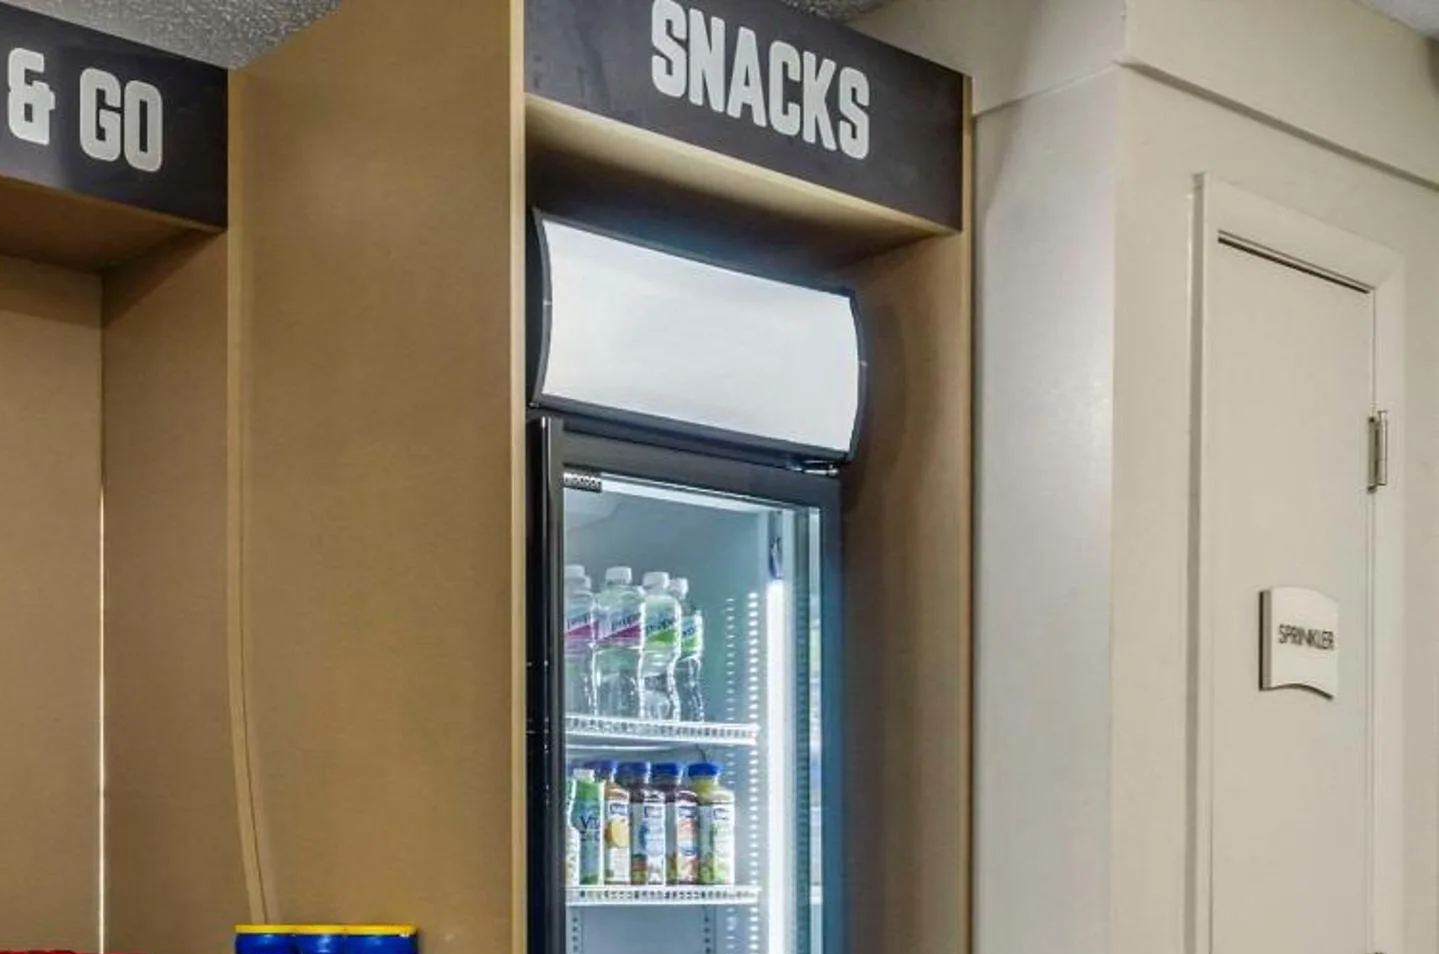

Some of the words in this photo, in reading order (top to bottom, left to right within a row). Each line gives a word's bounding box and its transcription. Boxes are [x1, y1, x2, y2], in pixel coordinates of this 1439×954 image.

[7, 47, 56, 145] &
[79, 67, 164, 172] GO
[651, 0, 871, 160] SNACKS
